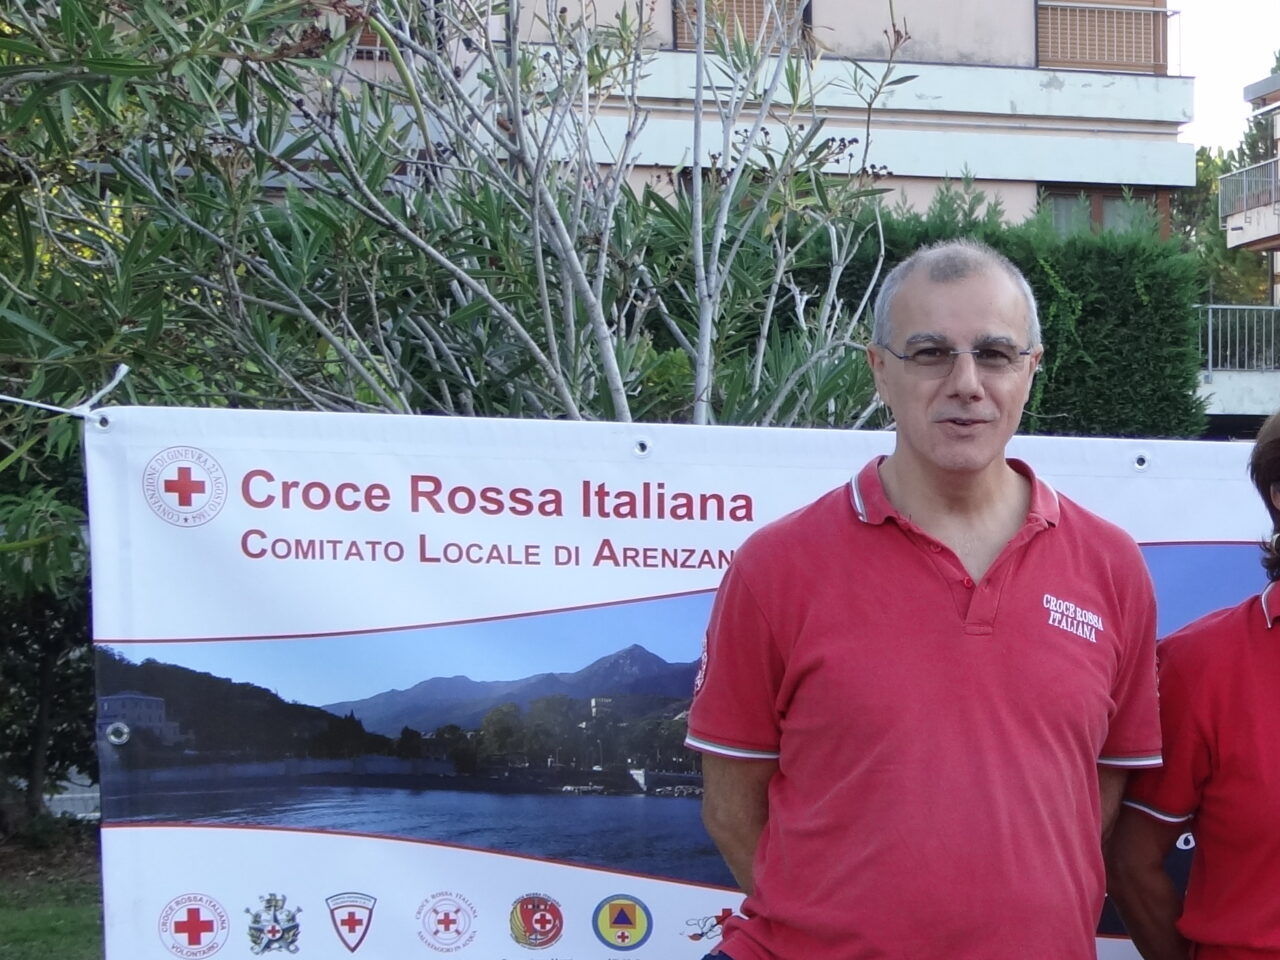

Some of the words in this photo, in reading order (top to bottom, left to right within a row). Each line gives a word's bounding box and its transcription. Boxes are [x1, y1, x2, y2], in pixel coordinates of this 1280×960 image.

[167, 448, 208, 467] GINEVRA
[240, 469, 391, 512] Croce
[411, 475, 564, 517] Rossa
[582, 480, 754, 522] Italiana
[241, 529, 405, 563] COMITATO
[419, 534, 541, 567] LOCALE
[554, 543, 581, 567] DI
[593, 539, 734, 571] ARENZAN
[1043, 593, 1076, 618] CROCE
[1076, 607, 1104, 631] ROSSA
[1048, 611, 1097, 643] ITALIANA
